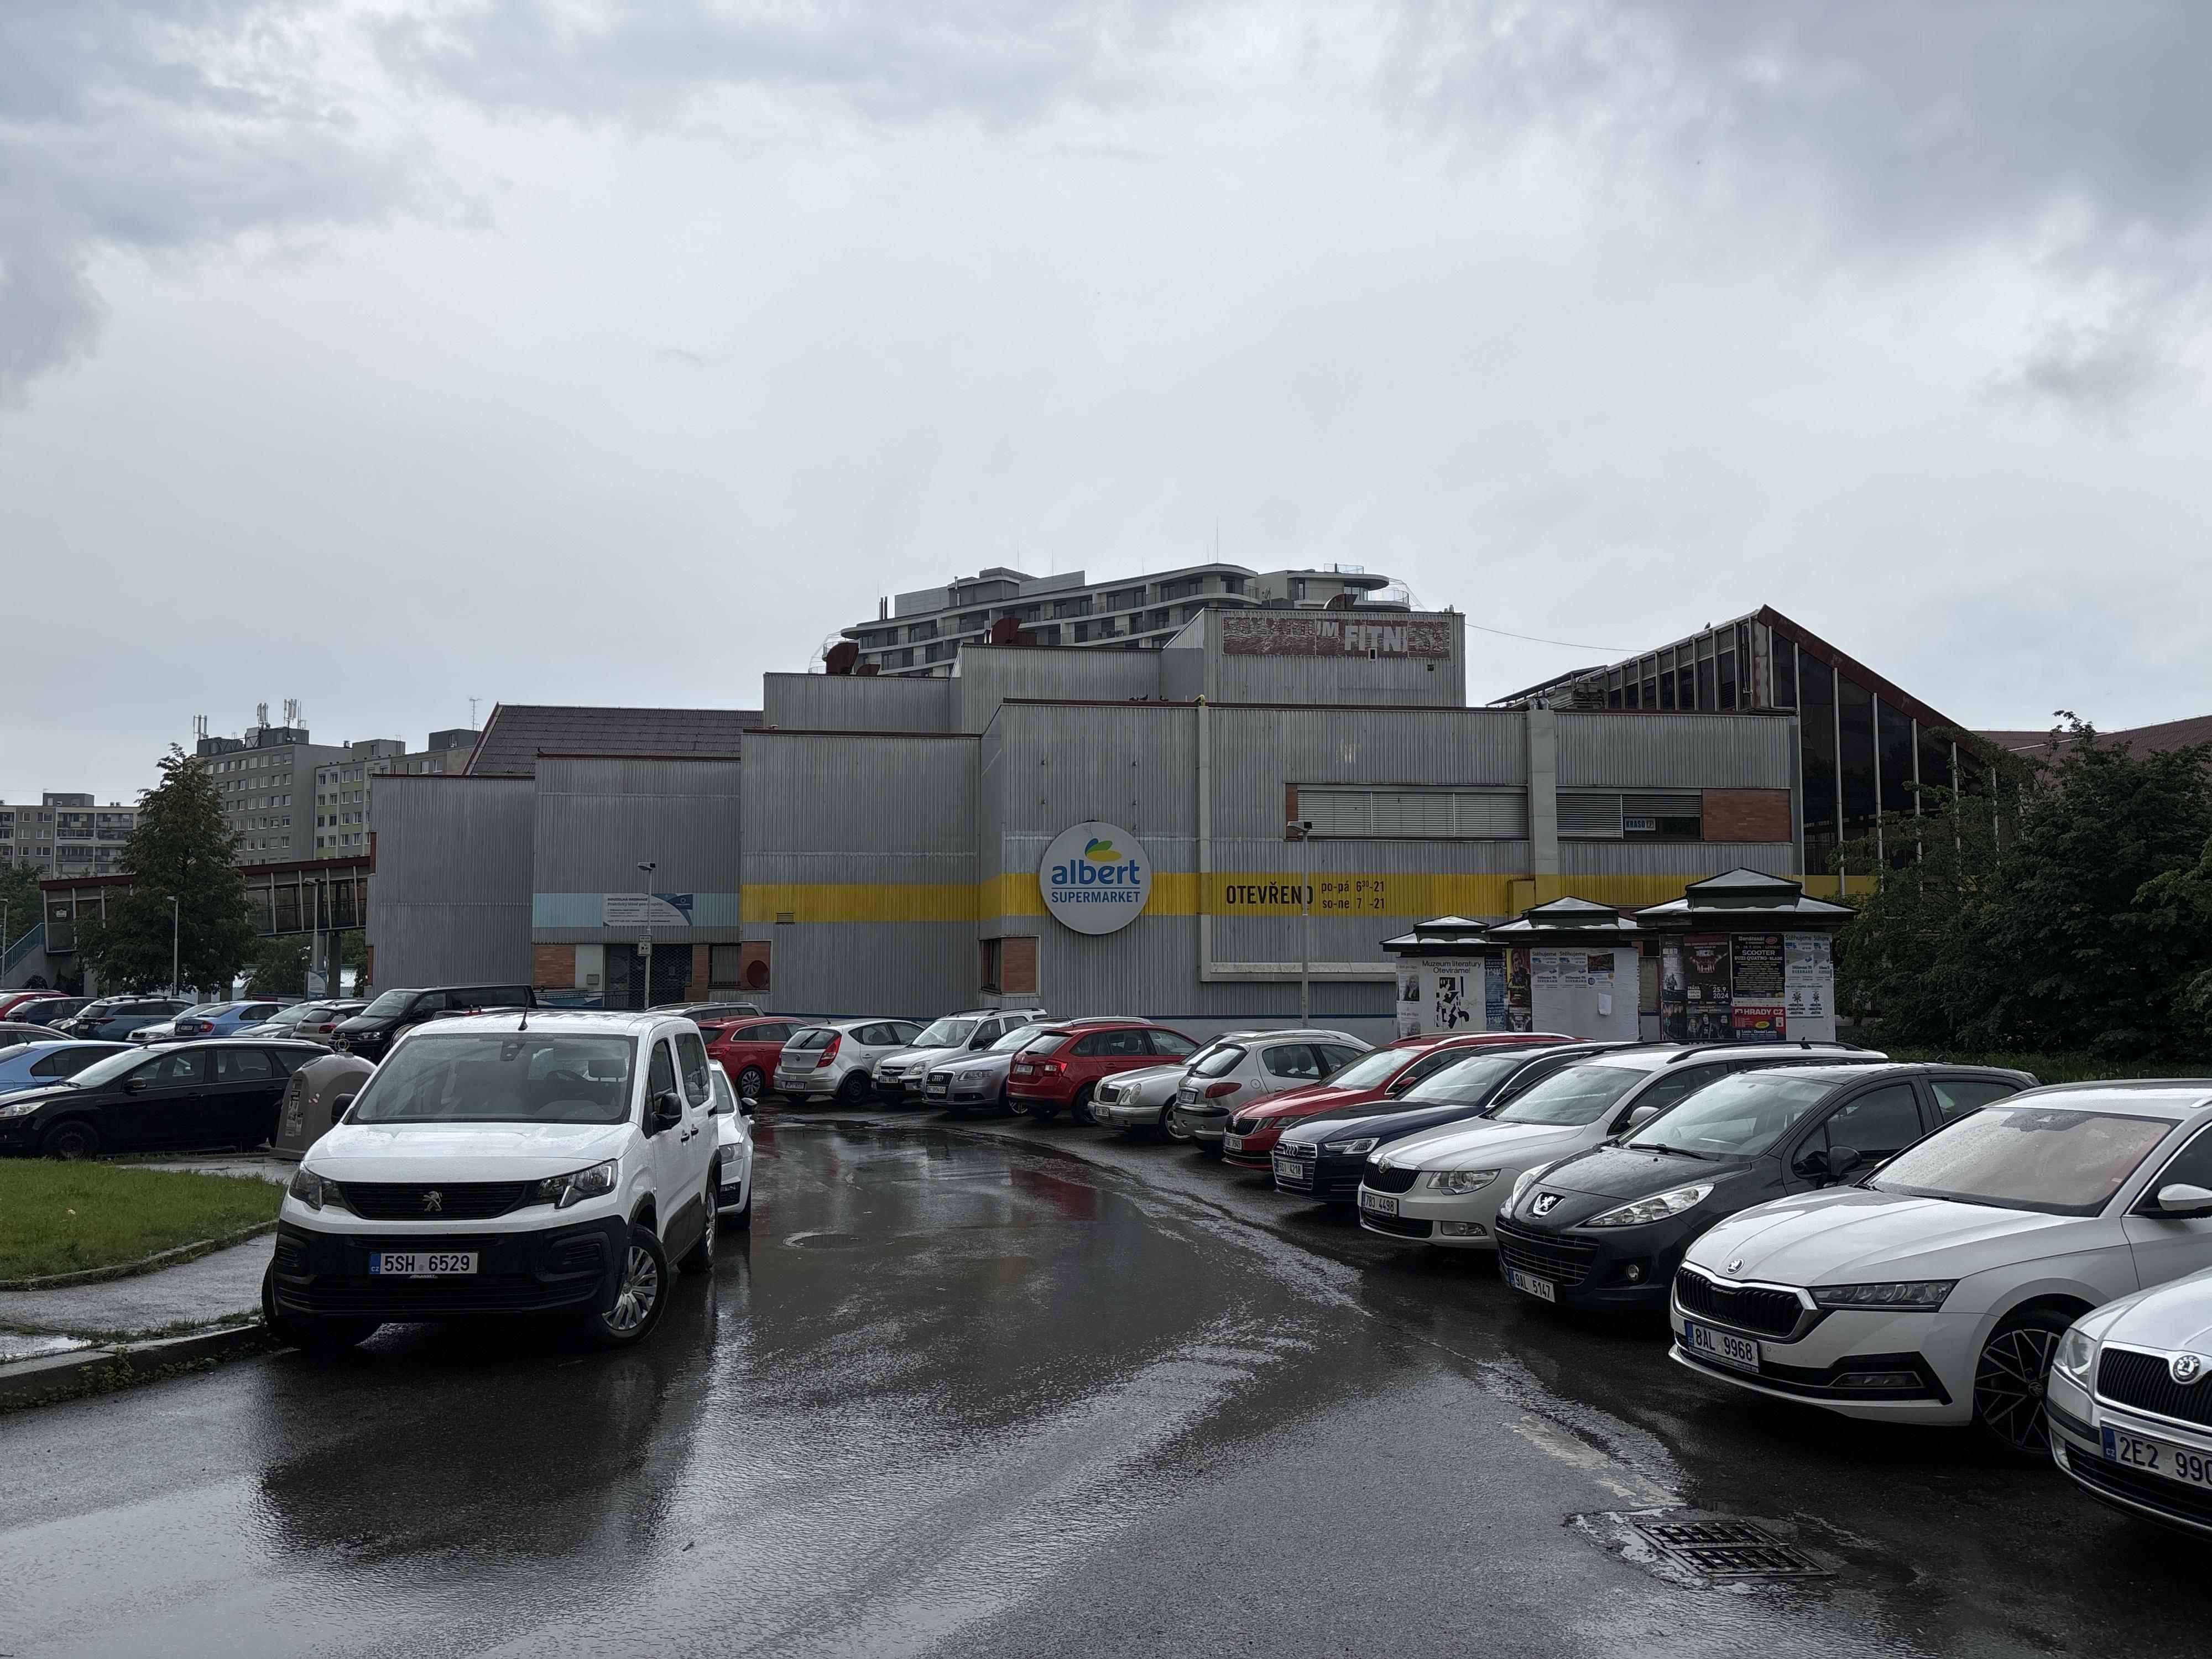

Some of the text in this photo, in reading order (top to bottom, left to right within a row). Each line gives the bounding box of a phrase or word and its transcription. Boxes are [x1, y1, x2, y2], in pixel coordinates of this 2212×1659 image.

[1626, 820, 1645, 828] KRASO
[1051, 859, 1141, 885] albert
[1321, 880, 1350, 894] po-pá
[1051, 891, 1141, 903] SUPERMARKET
[1322, 898, 1385, 909] so-ne 7 -21
[1785, 934, 1812, 942] Stěhujeme
[1452, 960, 1482, 968] literatury
[1290, 1164, 1301, 1175] 4218
[1366, 1194, 1394, 1212] 7B3 4498
[384, 1255, 415, 1272] 5SH
[429, 1255, 470, 1271] 6529
[1515, 1273, 1550, 1298] 9AL 5147
[1695, 1328, 1715, 1351] 8AL
[1723, 1336, 1752, 1361] 9968
[2106, 1448, 2115, 1457] CZ
[2120, 1436, 2159, 1470] 2E2
